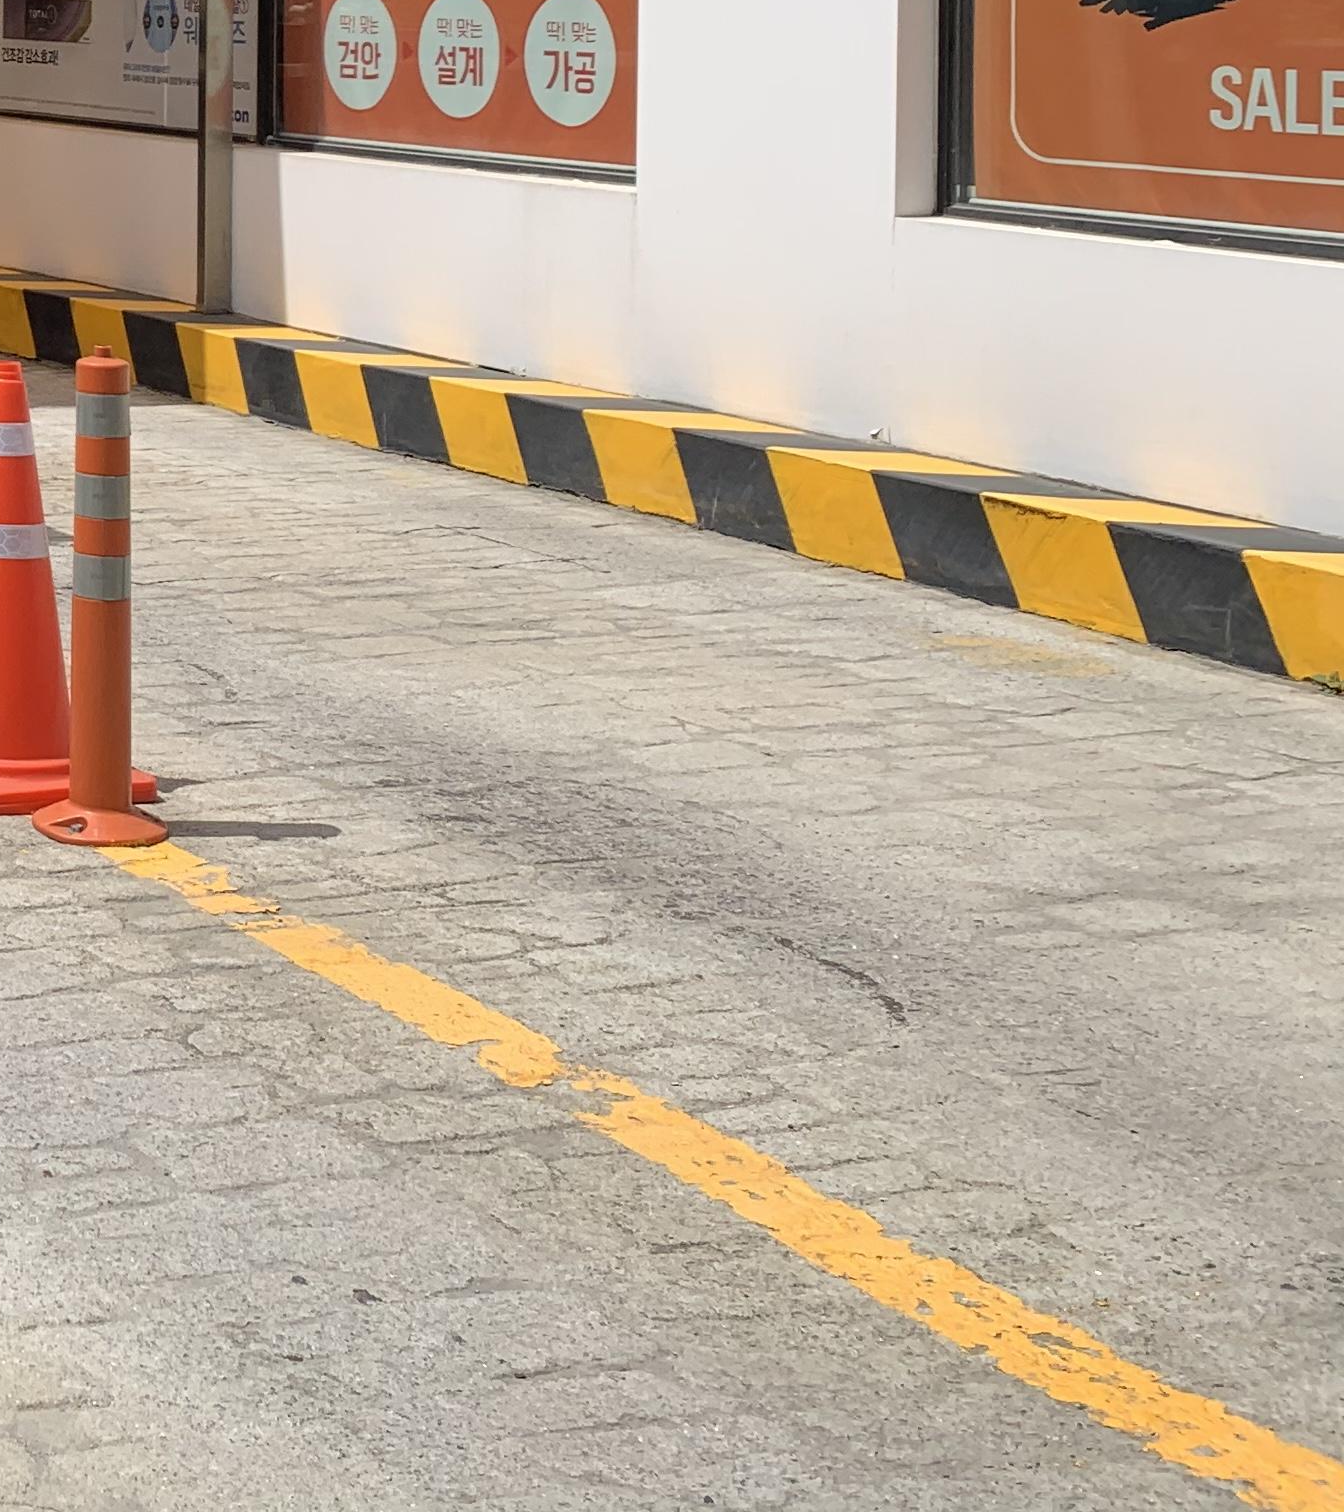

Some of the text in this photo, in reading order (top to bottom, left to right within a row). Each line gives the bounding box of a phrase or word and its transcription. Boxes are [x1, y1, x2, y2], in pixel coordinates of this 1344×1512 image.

[436, 17, 483, 39] 딱! 맞는
[546, 21, 597, 43] 딱! 맞는
[337, 40, 381, 81] 검안
[434, 44, 484, 87] 설계
[544, 49, 597, 95] 가공
[1209, 64, 1344, 137] SALE
